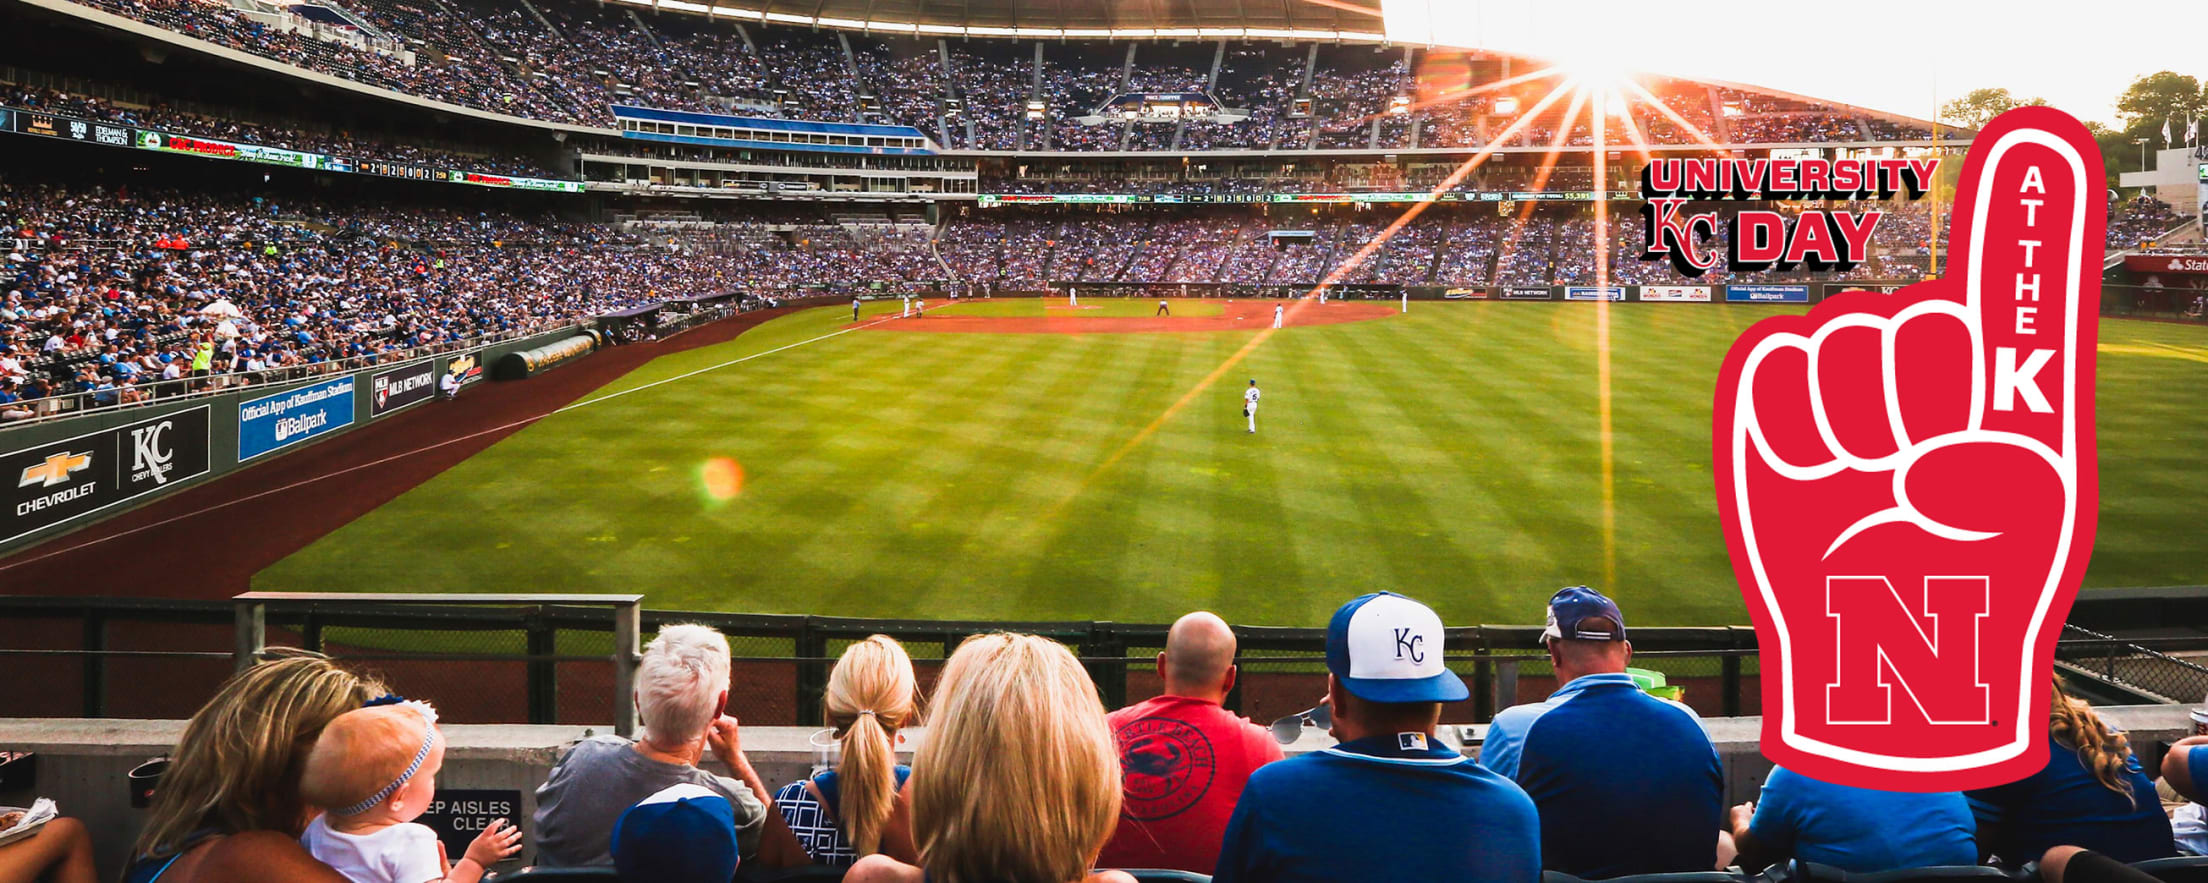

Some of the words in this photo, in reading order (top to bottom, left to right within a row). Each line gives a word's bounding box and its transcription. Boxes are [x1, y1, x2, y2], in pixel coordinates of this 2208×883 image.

[95, 125, 122, 137] EDELMAN
[96, 134, 128, 146] THOMPSON
[193, 139, 236, 157] PRODUCE
[389, 380, 403, 397] MLB
[403, 371, 433, 393] NETWORK
[241, 400, 270, 422] Official
[269, 398, 286, 416] App
[287, 395, 295, 409] of
[294, 386, 328, 407] Kauffman
[327, 382, 354, 399] Stadium
[288, 408, 327, 436] Ballpark
[131, 420, 173, 485] KC
[131, 469, 150, 483] CHEVY
[16, 481, 97, 517] CHEVROLET
[1391, 626, 1425, 665] KC
[450, 800, 511, 815] AISLES
